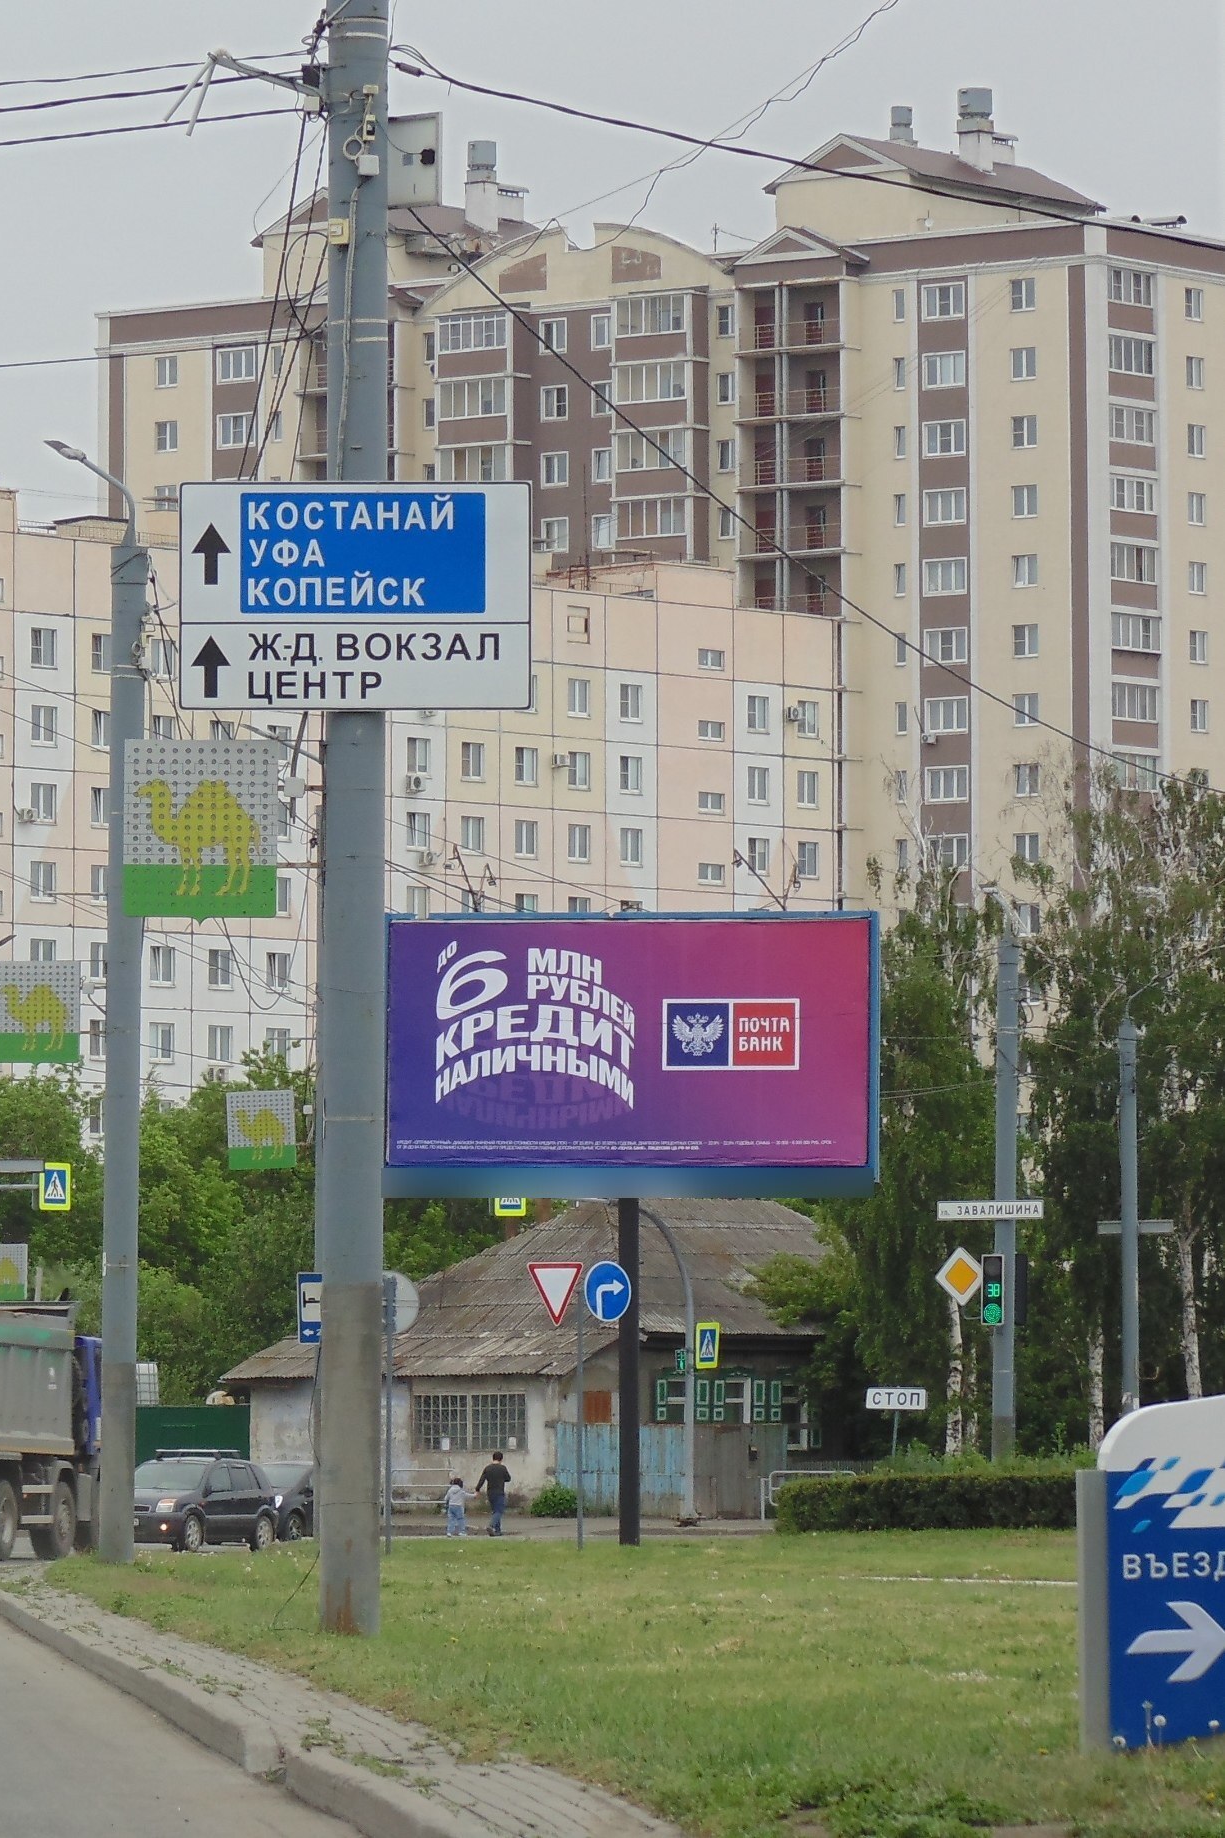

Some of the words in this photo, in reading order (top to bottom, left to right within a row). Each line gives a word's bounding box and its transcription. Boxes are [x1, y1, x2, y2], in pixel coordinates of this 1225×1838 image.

[247, 494, 455, 530] КОСТАНАЙ
[248, 538, 325, 568] УФА
[247, 570, 425, 607] КОПЕЙСК
[336, 632, 501, 661] ВОКЗАЛ
[247, 671, 383, 705] ЦЕНТР
[436, 940, 458, 974] ДО
[527, 947, 603, 986] МЛН
[436, 950, 509, 1020] 6
[527, 974, 635, 1040] РУБЛЕЙ
[436, 1004, 635, 1071] КРЕДИТ
[738, 1017, 791, 1033] ПОЧТА
[738, 1036, 784, 1052] БАНК
[435, 1044, 634, 1110] НАЛИЧНЫМИ
[956, 1204, 1040, 1216] ЗАВАЛИШИНА
[872, 1391, 921, 1406] СТОП
